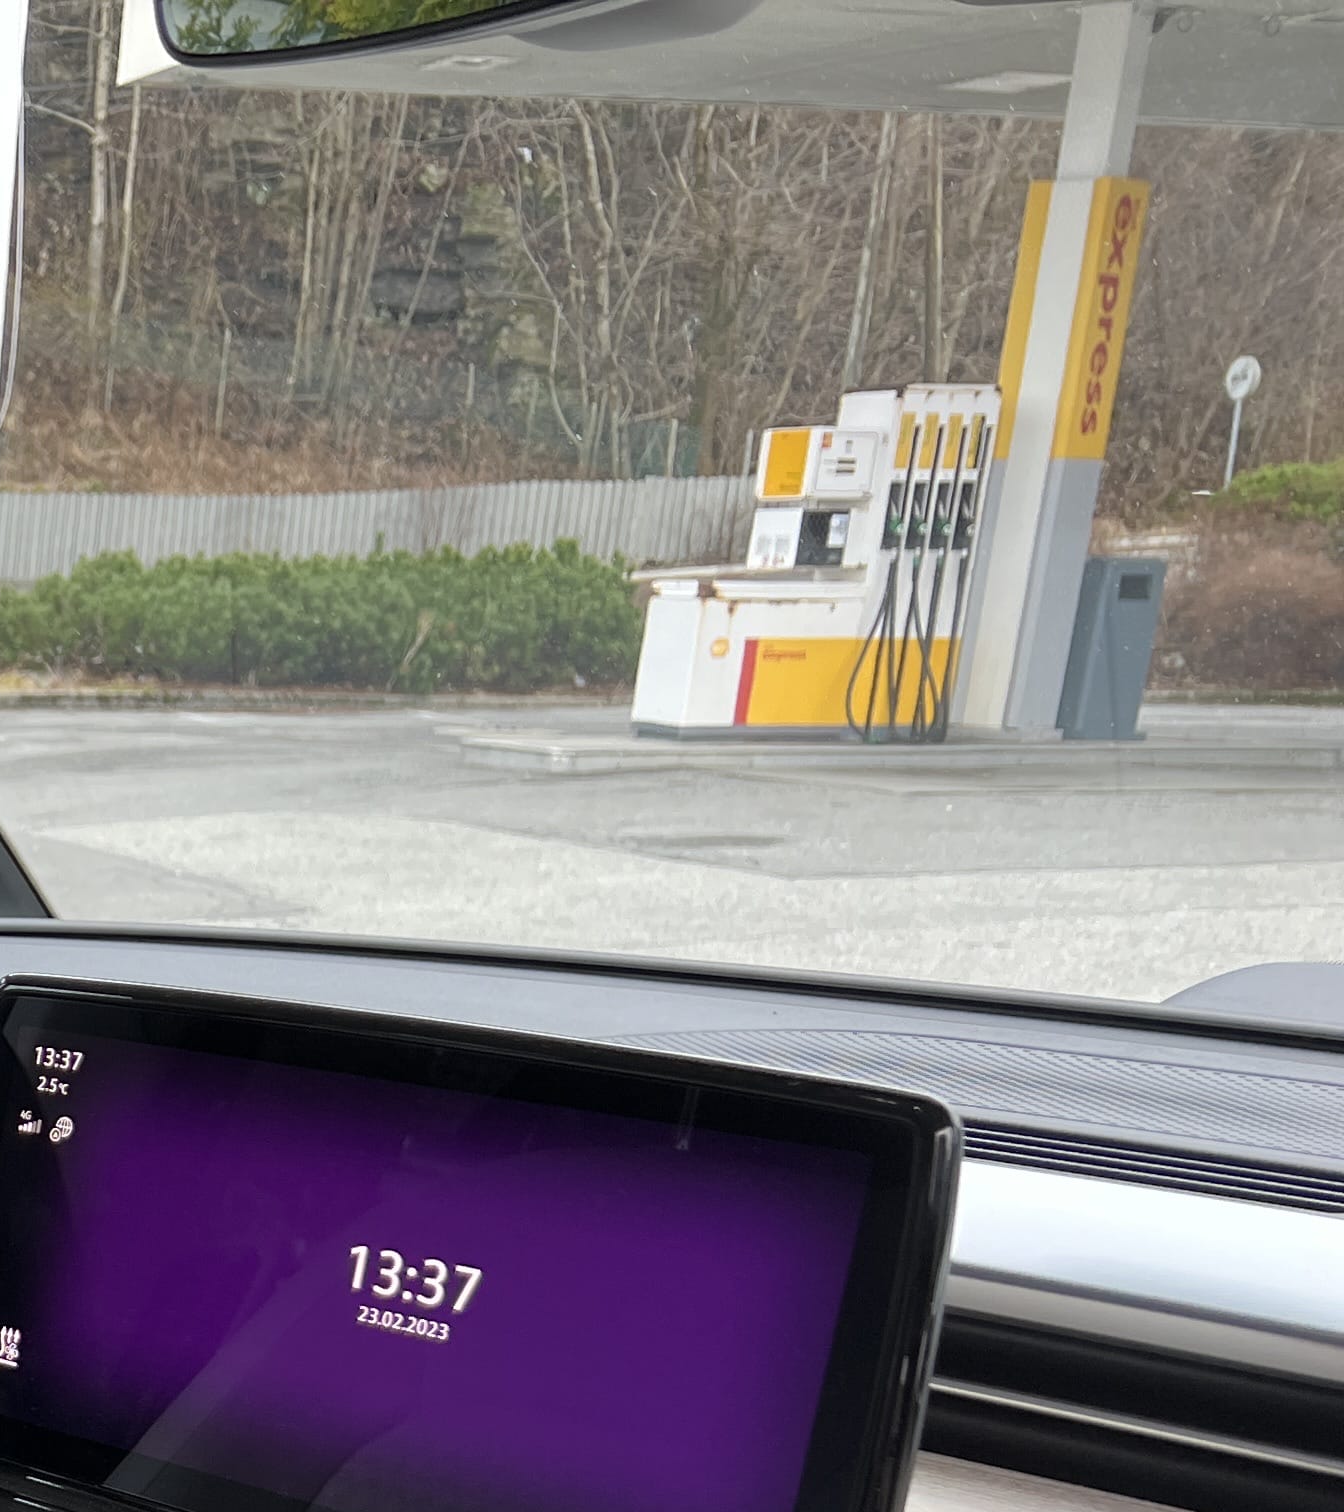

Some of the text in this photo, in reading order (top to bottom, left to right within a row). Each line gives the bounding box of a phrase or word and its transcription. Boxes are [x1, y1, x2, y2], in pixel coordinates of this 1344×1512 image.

[1080, 194, 1133, 436] express
[35, 1046, 83, 1071] 13:37
[349, 1244, 483, 1315] 13:37
[356, 1304, 451, 1342] 23.02.2023
